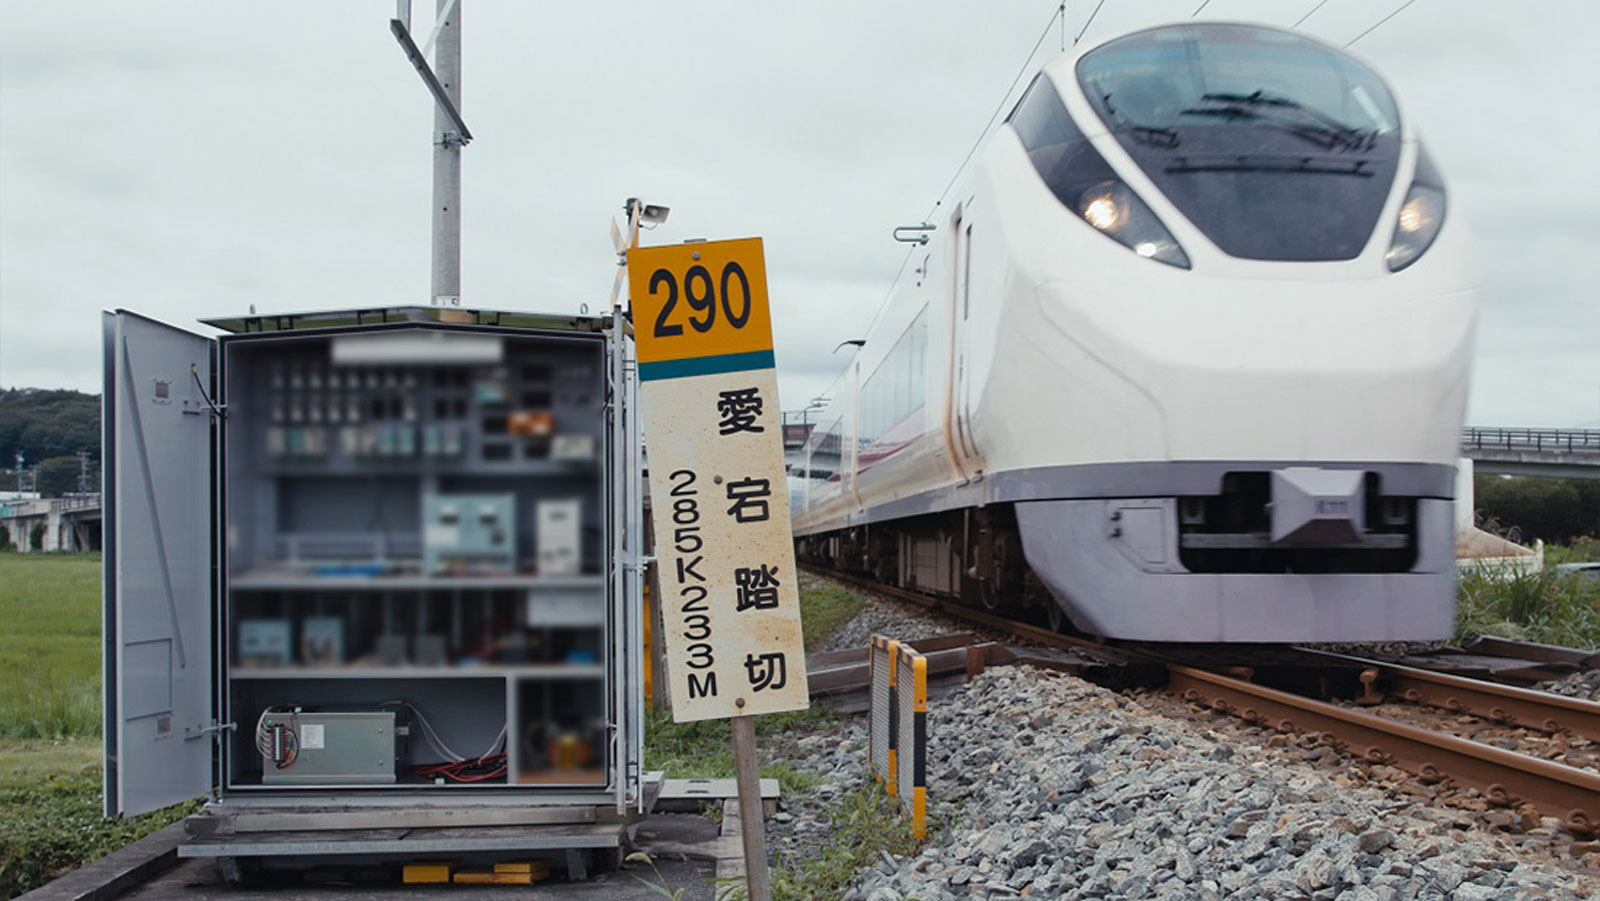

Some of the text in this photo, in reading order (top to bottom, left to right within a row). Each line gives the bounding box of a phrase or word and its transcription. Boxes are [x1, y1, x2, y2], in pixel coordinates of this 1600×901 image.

[649, 261, 751, 337] 290
[669, 470, 718, 699] 285K233M
[717, 387, 786, 692] 愛宕踏切
